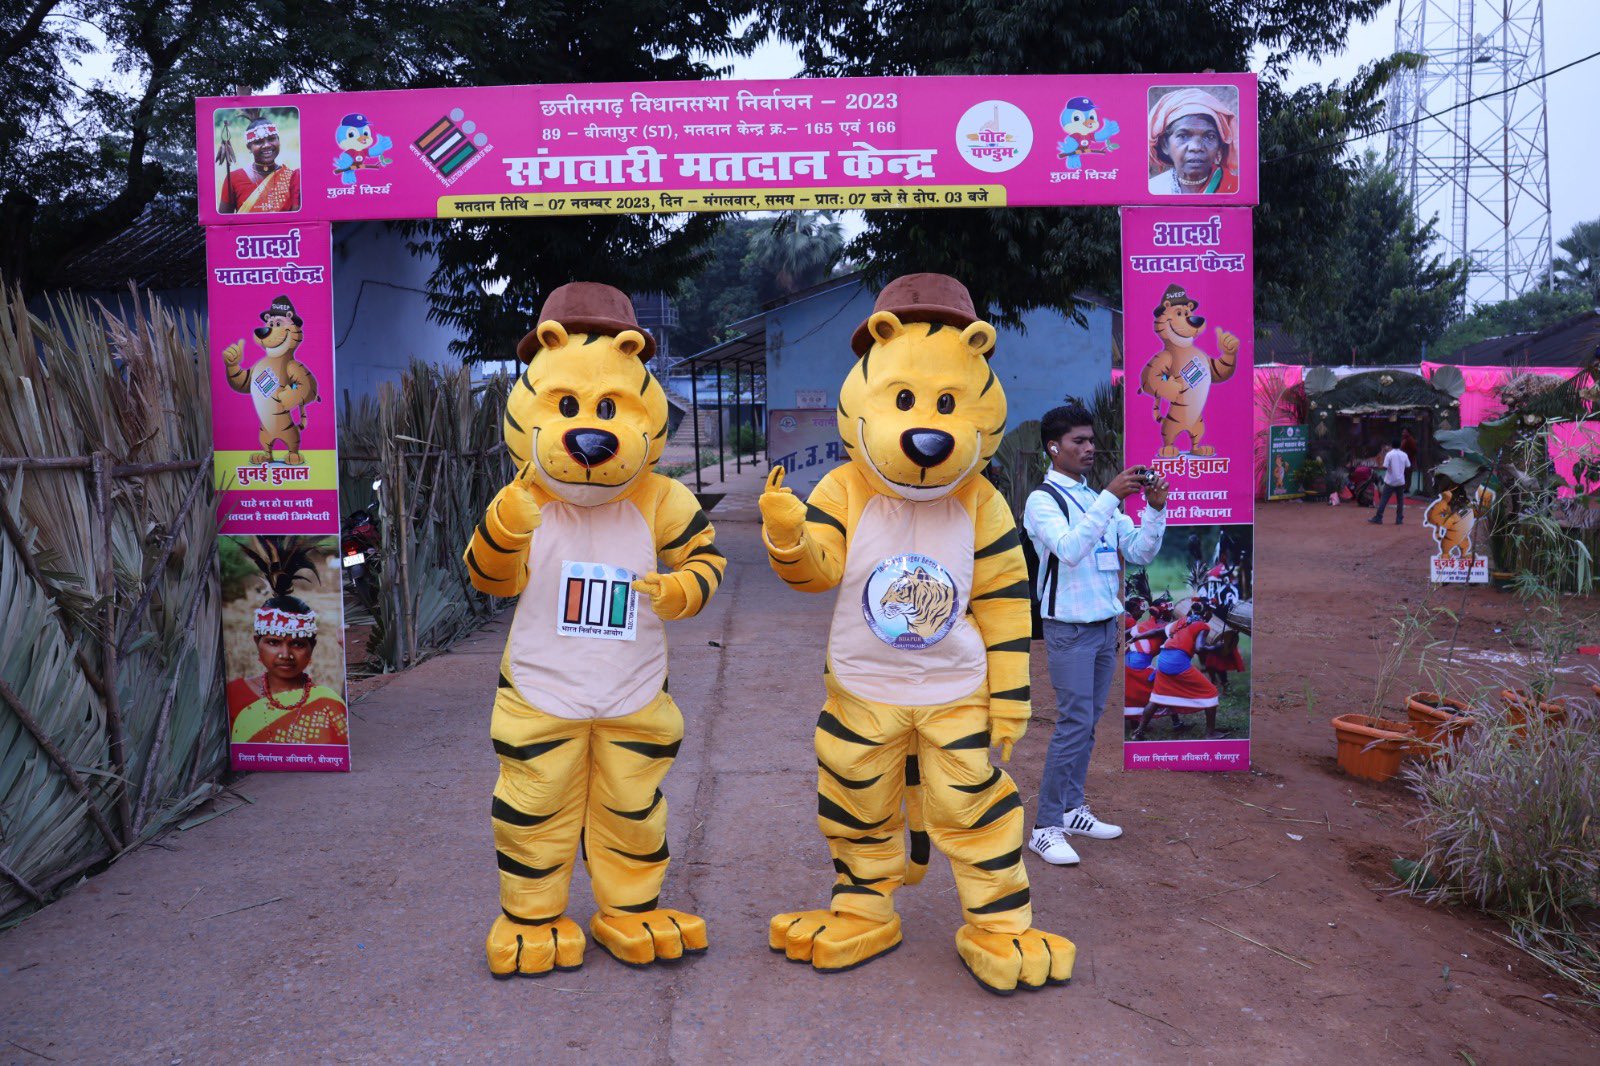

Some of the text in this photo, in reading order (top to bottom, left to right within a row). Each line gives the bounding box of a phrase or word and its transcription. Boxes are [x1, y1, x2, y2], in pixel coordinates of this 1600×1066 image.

[539, 94, 624, 118] छत्तीसगढ़
[630, 91, 729, 113] विधानसभा
[736, 88, 813, 111] निर्वाचन
[845, 92, 898, 110] 2023
[542, 128, 561, 141] 89
[584, 122, 638, 143] बीजापुर
[642, 124, 679, 140] (ST),
[683, 123, 731, 137] मतदान
[737, 119, 765, 137] केन्द्र
[804, 122, 833, 135] 165
[839, 119, 861, 137] एवं
[867, 121, 896, 134] 166
[978, 129, 1006, 142] वोट
[970, 147, 1015, 162] पण्डुम
[502, 141, 938, 187] संगवारी मतदान केन्द्र
[1049, 168, 1119, 183] चुनई चिरई
[326, 182, 393, 199] चुनई चिरई
[454, 200, 496, 213] मतदान
[500, 196, 529, 212] तिथि
[548, 198, 566, 211] 07
[570, 197, 612, 210] नवम्बर
[616, 196, 656, 211] 2023,
[659, 192, 684, 207] दिन
[702, 193, 760, 208] मंगलवार,
[765, 194, 795, 206] समय
[848, 193, 867, 205] 07
[871, 189, 892, 204] बजे
[897, 189, 908, 204] से
[912, 189, 940, 204] दोप.
[944, 191, 963, 204] 03
[967, 188, 989, 203] बजे
[1153, 215, 1221, 246] आदर्श
[236, 228, 300, 259] आदर्श
[1130, 249, 1245, 273] मतदान केन्द्र
[215, 261, 324, 285] मतदान केन्द्र
[1166, 291, 1186, 299] SWEEP
[272, 303, 290, 311] SWEEP
[237, 461, 310, 486] चुनई डुवाल
[1188, 457, 1230, 479] डुवाल
[272, 497, 281, 507] हो
[295, 497, 314, 507] नारी
[255, 511, 261, 521] है
[562, 625, 623, 636] भारत निर्वाचन आयोग
[257, 753, 283, 762] निर्वाचन
[1152, 752, 1178, 762] निर्वाचन
[1214, 751, 1240, 763] बीजापुर
